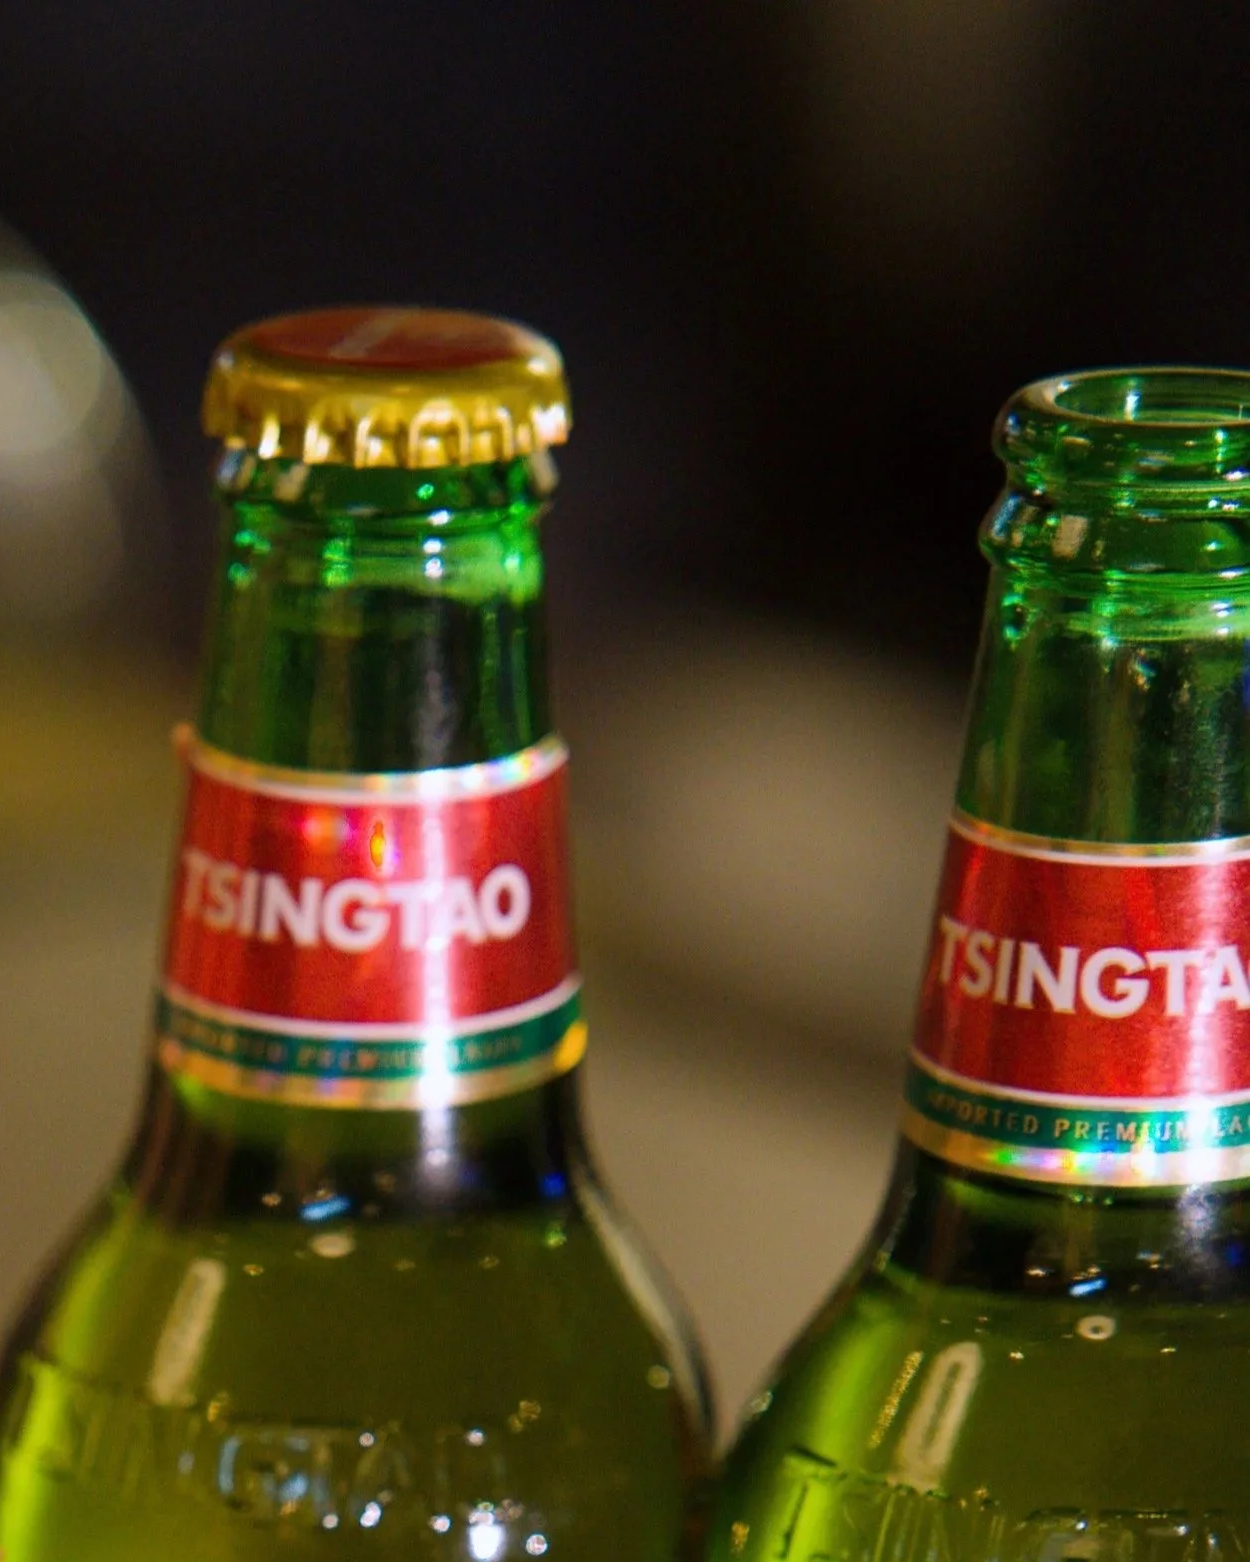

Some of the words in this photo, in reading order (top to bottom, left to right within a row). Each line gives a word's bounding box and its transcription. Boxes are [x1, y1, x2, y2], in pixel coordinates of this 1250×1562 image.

[182, 848, 532, 954] TSINGTAO
[938, 913, 1250, 1019] TSINGTA
[1214, 1112, 1250, 1139] LA
